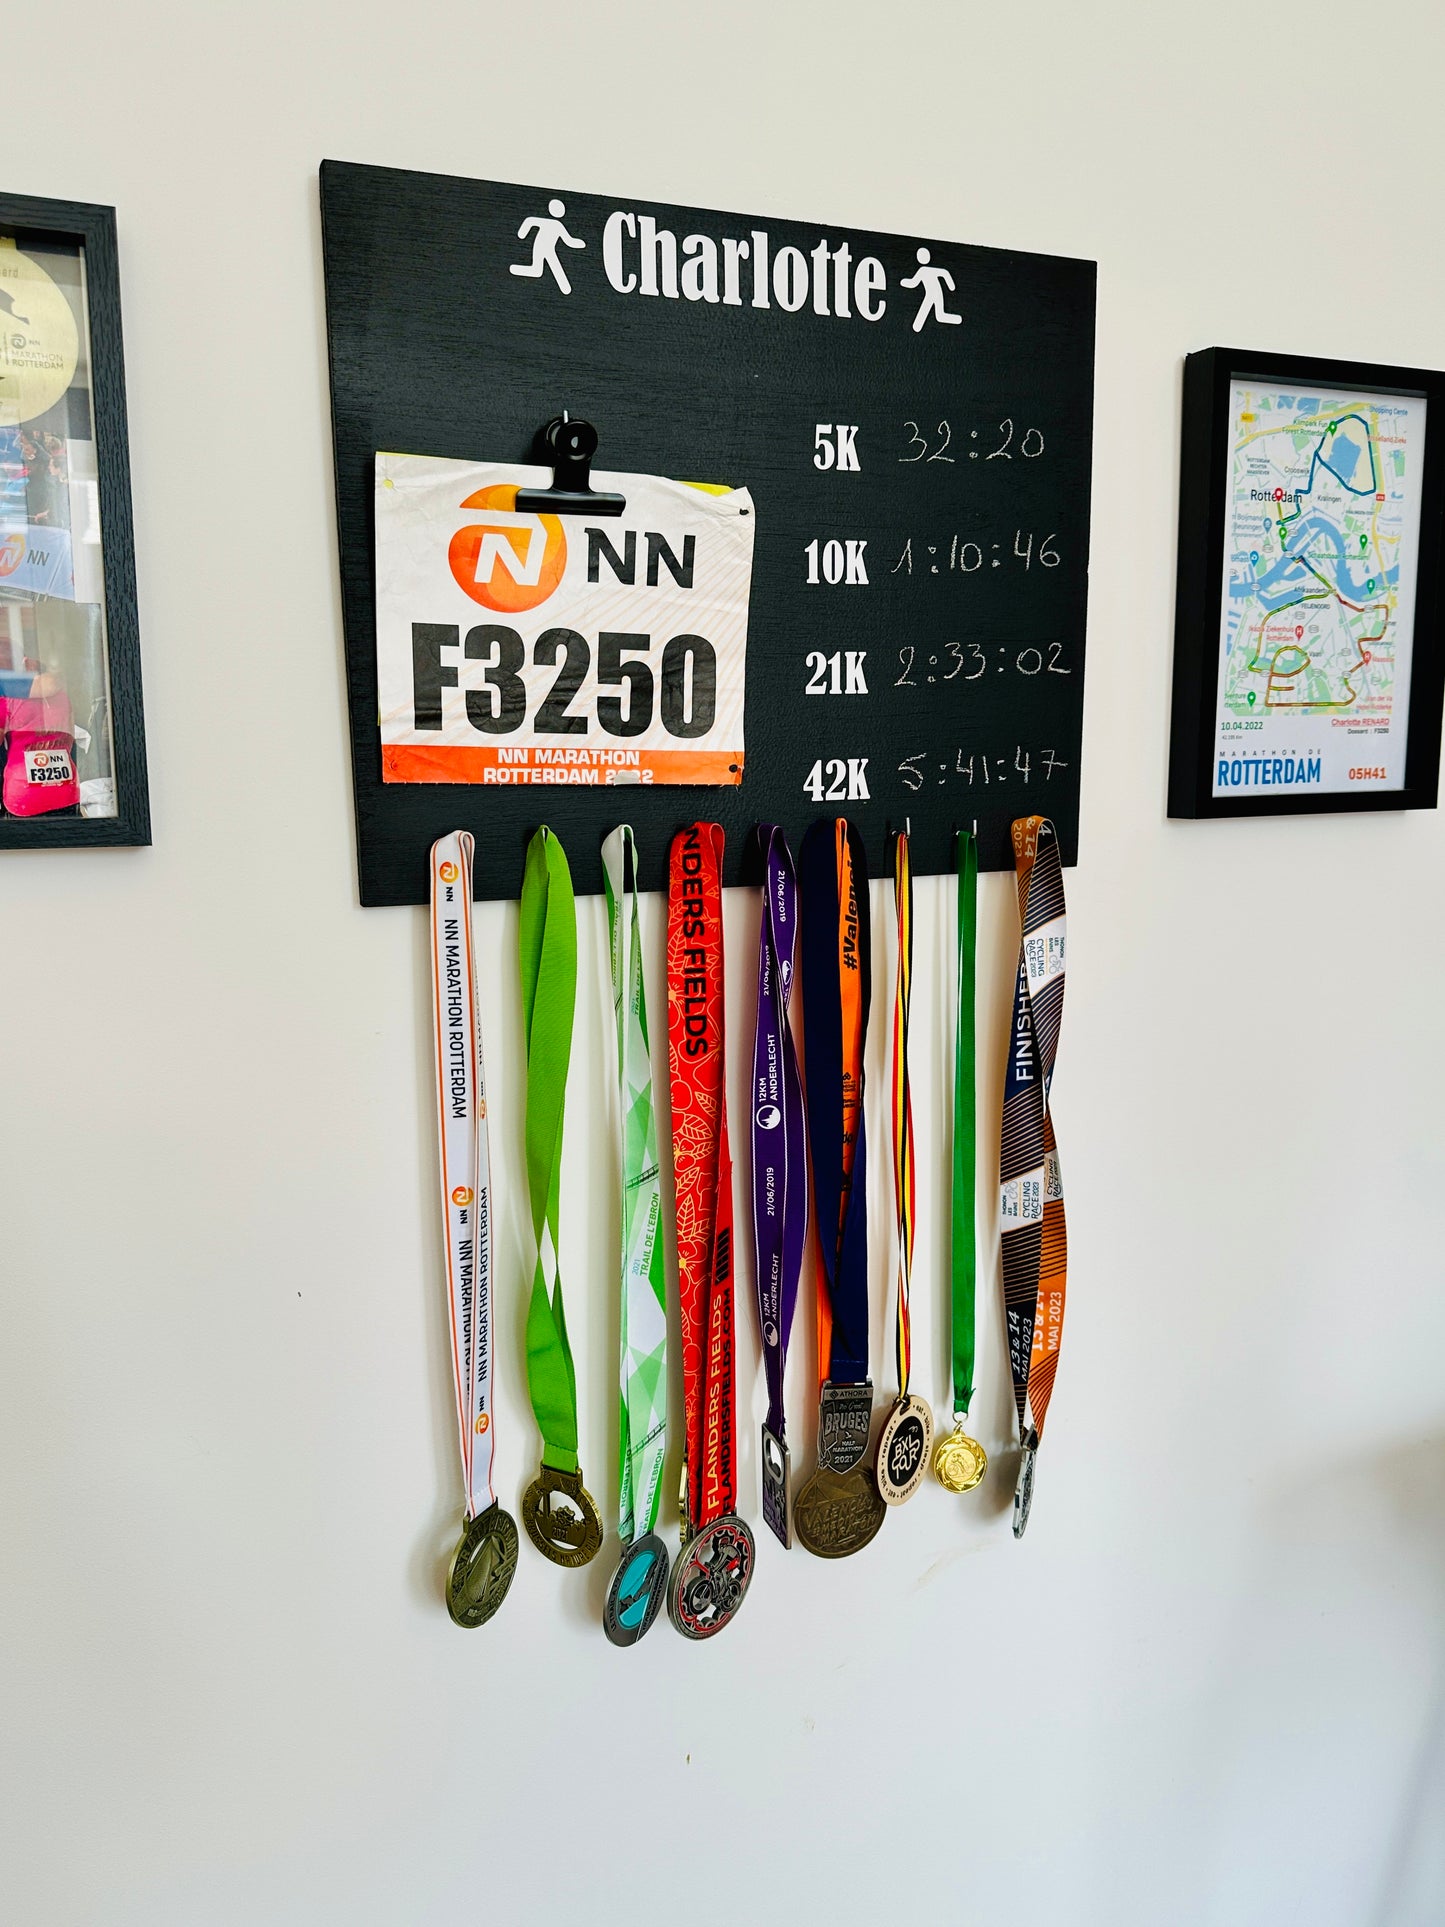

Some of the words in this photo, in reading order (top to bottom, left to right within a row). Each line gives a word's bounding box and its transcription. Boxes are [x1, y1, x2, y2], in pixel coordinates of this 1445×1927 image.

[602, 210, 887, 323] Charlotte
[11, 350, 64, 362] MARATHON
[12, 359, 65, 370] ROTTERDAM
[813, 423, 861, 472] 5K
[1250, 489, 1303, 503] Rottedam
[27, 549, 50, 567] NN
[584, 527, 697, 589] NN
[804, 538, 870, 585] 10K
[411, 621, 718, 739] F3250
[805, 651, 869, 695] 21K
[1220, 721, 1263, 731] 10.04.2022
[1331, 718, 1362, 728] Charlotte
[1362, 718, 1390, 727] RENARD
[50, 755, 64, 763] NN
[497, 748, 530, 765] NN
[534, 748, 641, 766] MARATHON
[1220, 749, 1296, 758] MARATHON
[1308, 748, 1321, 756] DE
[30, 766, 70, 782] F3250
[483, 767, 599, 784] ROTTERDAM
[604, 768, 654, 785] 22
[802, 758, 871, 802] 42K
[1218, 758, 1321, 787] ROTTERDAM
[1348, 767, 1387, 781] 05H41
[446, 886, 453, 902] NN
[777, 870, 787, 923] 21/06/2019
[444, 919, 458, 941] NN
[1026, 939, 1037, 962] RACE
[1036, 938, 1045, 977] CYCLING
[446, 945, 463, 1027] MARATHON
[684, 947, 708, 1057] FIELDS
[449, 1031, 467, 1119] ROTTERDAM
[768, 1033, 778, 1101] ANDERLECHT
[758, 1077, 767, 1102] 12KM
[1032, 1182, 1040, 1197] 2023
[1046, 1159, 1055, 1195] CYCLING
[1053, 1175, 1062, 1198] RACE
[766, 1166, 775, 1217] 21/06/2019
[1023, 1181, 1031, 1218] CYCLING
[460, 1209, 467, 1225] NN
[647, 1192, 660, 1233] L'EBRON
[1031, 1197, 1042, 1219] RACE
[479, 1186, 488, 1277] ROTTERDAM
[644, 1234, 654, 1248] DE
[459, 1239, 472, 1262] NN
[640, 1249, 652, 1277] TRAIL
[631, 1259, 641, 1276] 2021
[770, 1254, 780, 1321] ANDERLECHT
[479, 1277, 488, 1357] MARATHON
[1049, 1291, 1062, 1323] 2023
[1008, 1310, 1020, 1335] 14
[1022, 1317, 1033, 1352] 2023
[710, 1294, 723, 1380] FIELDS
[1047, 1325, 1060, 1351] MAI
[479, 1358, 487, 1383] NN
[1011, 1349, 1021, 1375] 13
[1021, 1354, 1029, 1382] MAI
[719, 1287, 733, 1512] FLANDERSFIELDS.COM
[839, 1390, 868, 1398] ATHORA
[824, 1410, 869, 1436] BRUGES
[923, 1415, 931, 1435] bike
[706, 1382, 721, 1509] FLANDERS
[919, 1444, 930, 1471] sleep
[649, 1448, 663, 1489] L'EBRON
[834, 1455, 853, 1464] 2021
[646, 1490, 654, 1505] DE
